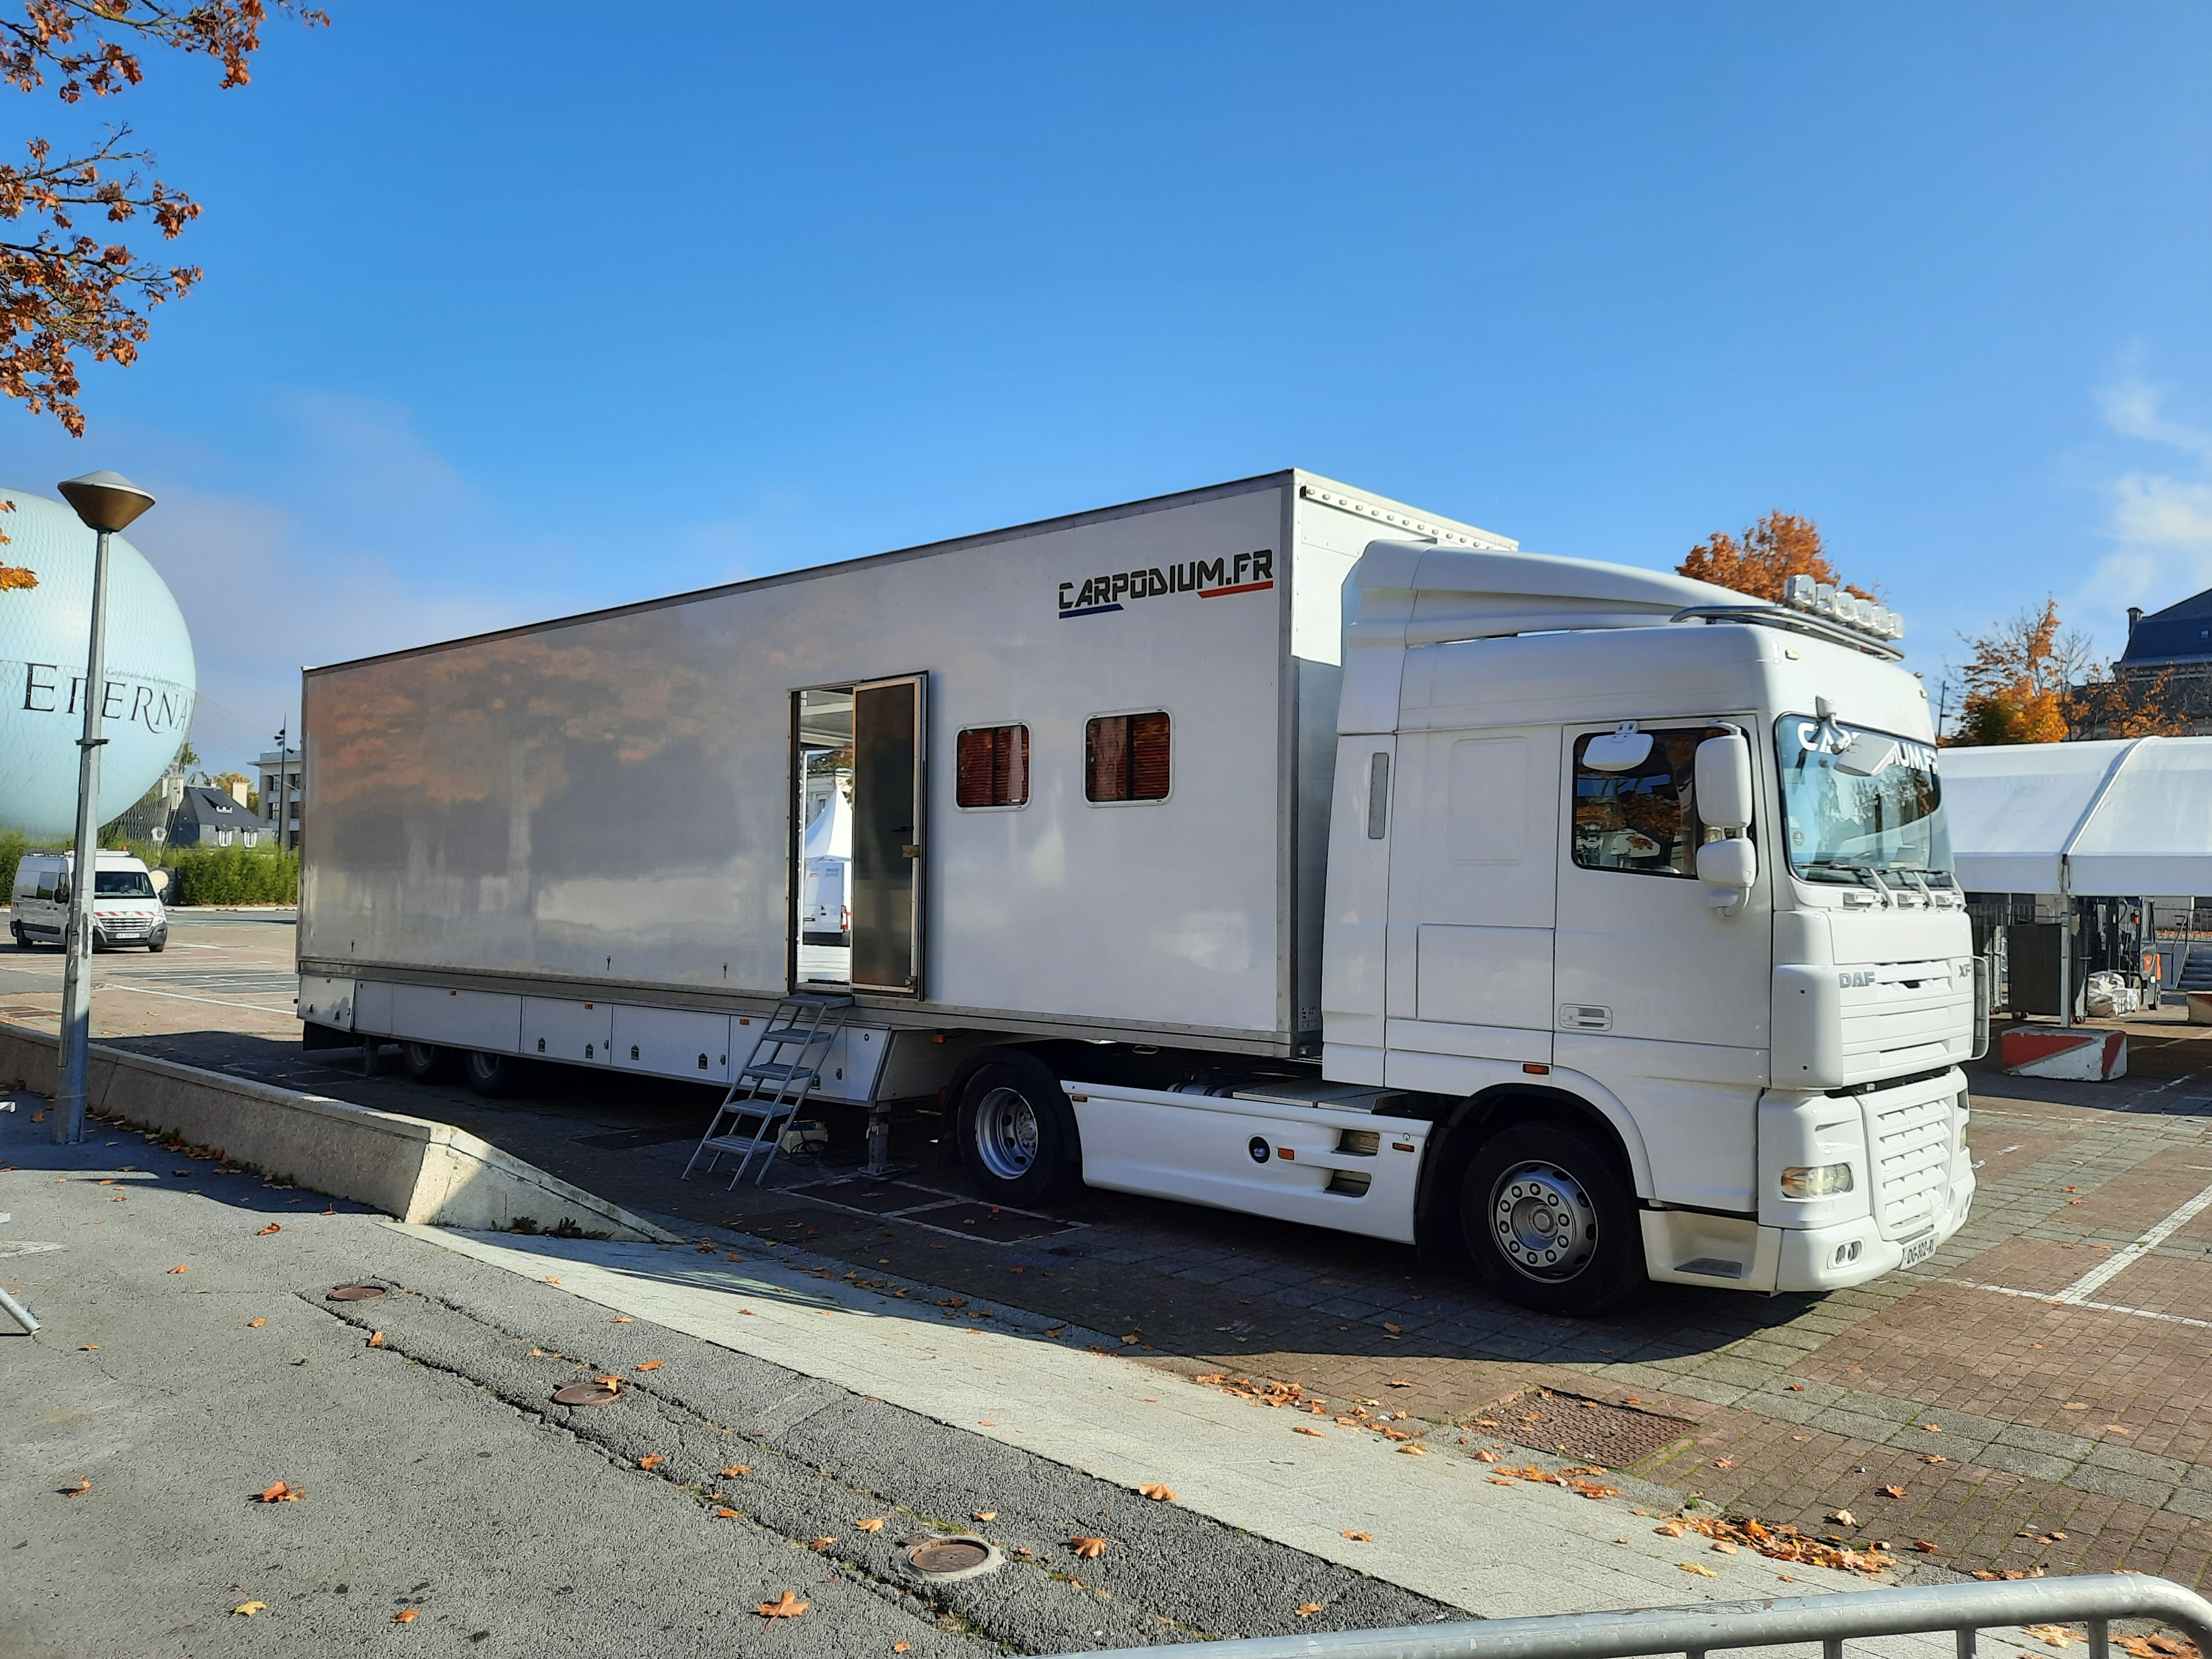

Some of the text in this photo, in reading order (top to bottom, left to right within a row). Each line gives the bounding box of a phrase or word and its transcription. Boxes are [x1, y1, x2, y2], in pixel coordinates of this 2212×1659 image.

[1059, 549, 1274, 609] CARPODIUM.FR
[19, 662, 193, 733] EPERNA
[1839, 972, 1875, 988] DAF
[1958, 964, 1971, 978] XF
